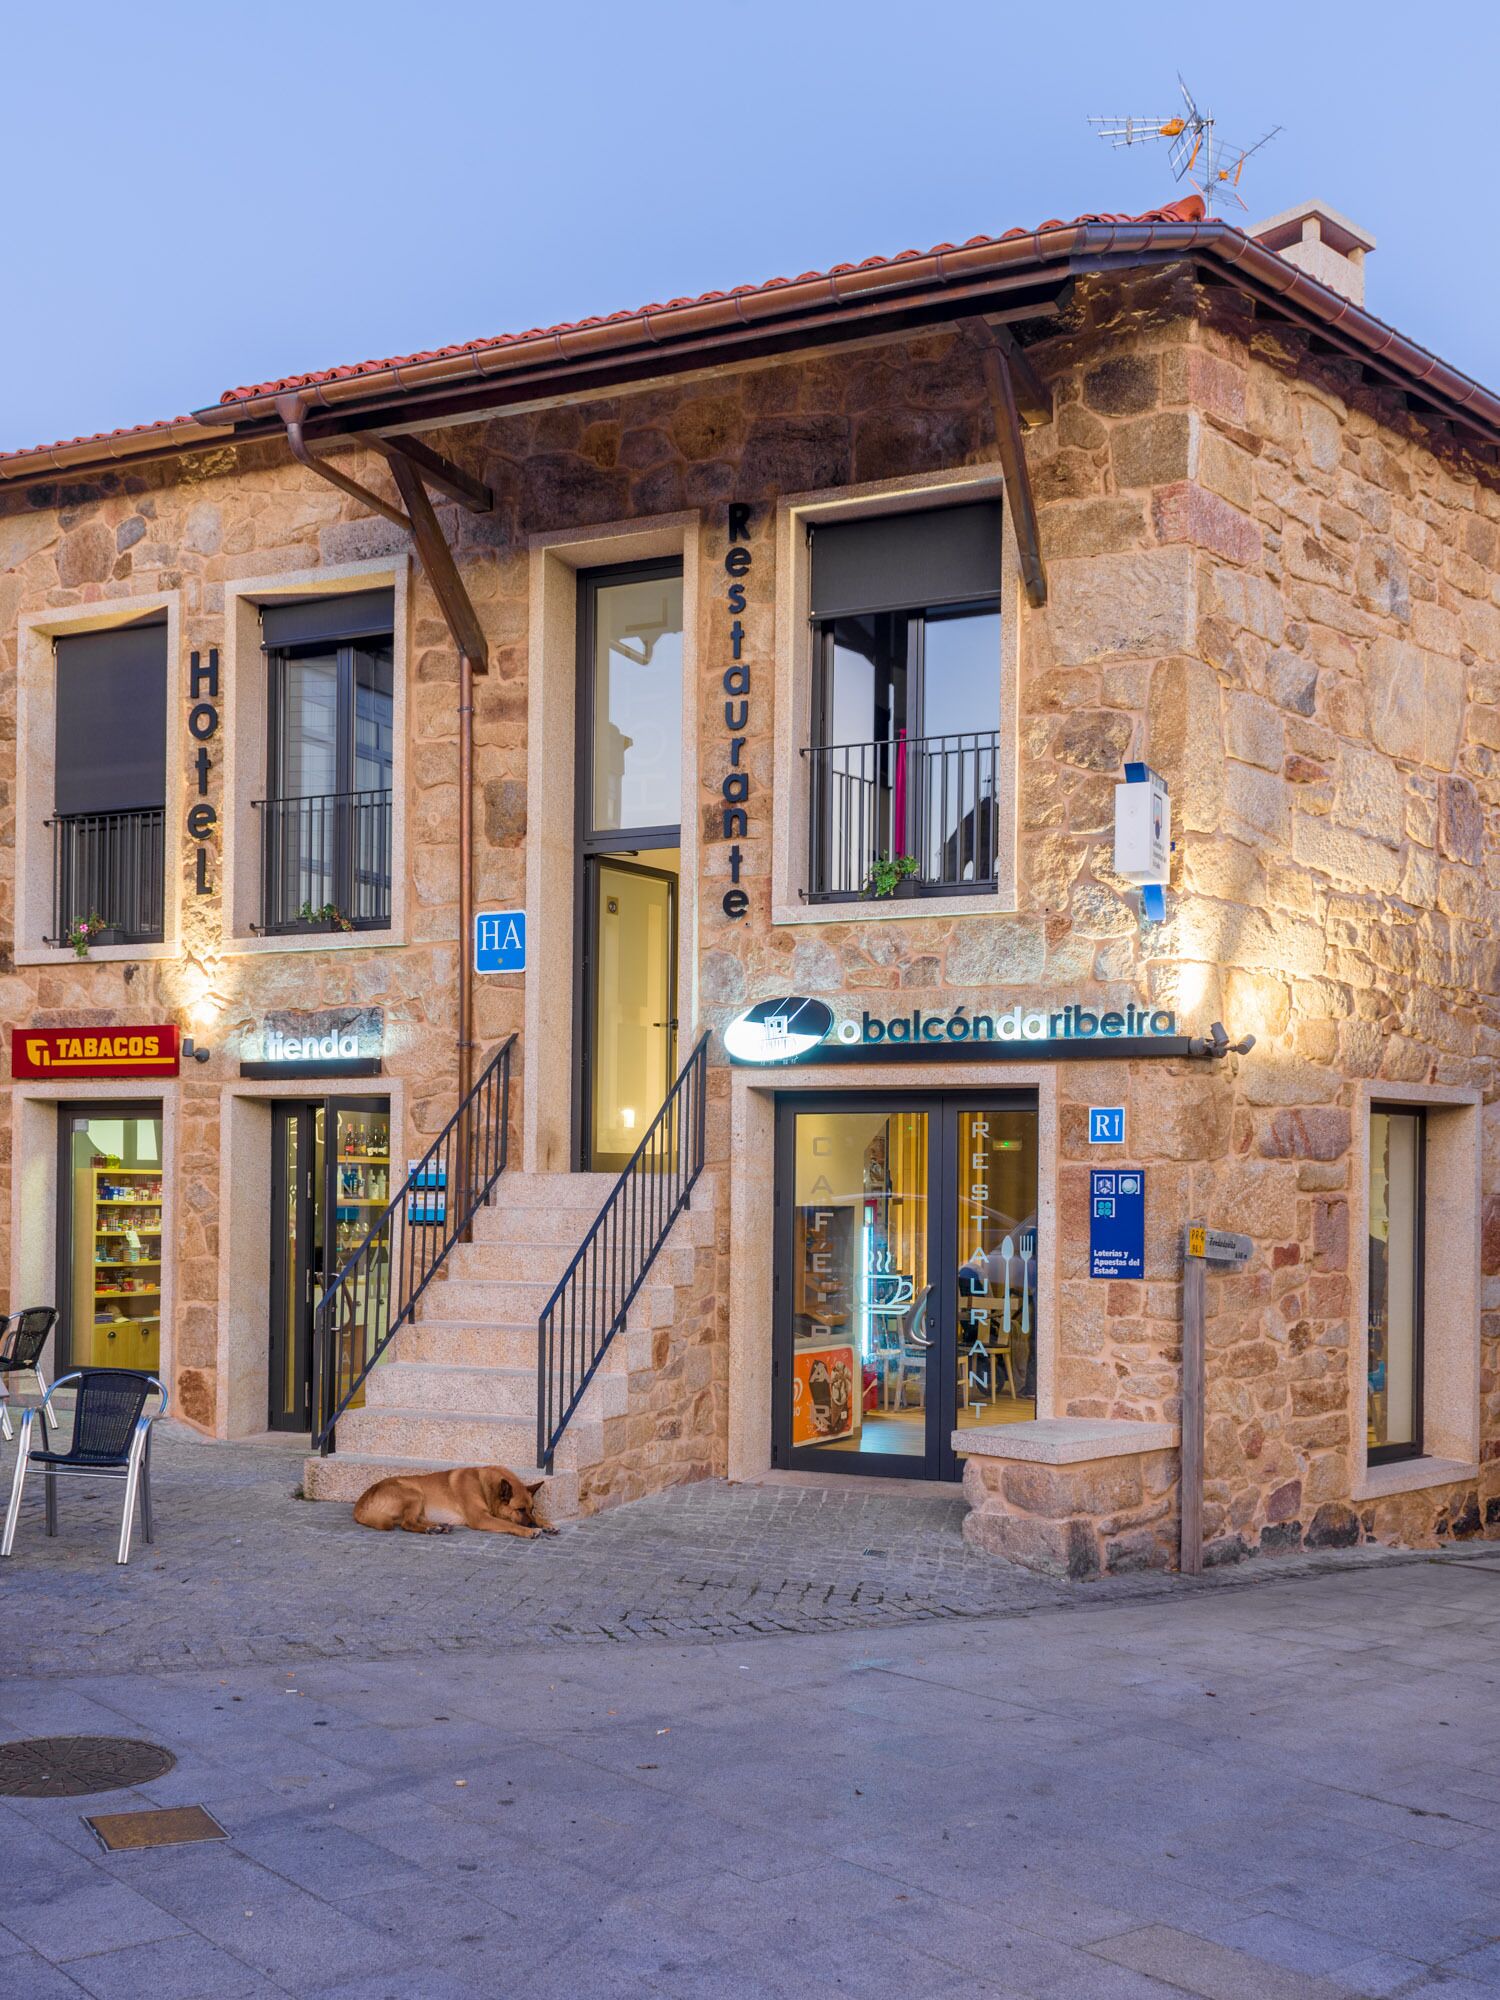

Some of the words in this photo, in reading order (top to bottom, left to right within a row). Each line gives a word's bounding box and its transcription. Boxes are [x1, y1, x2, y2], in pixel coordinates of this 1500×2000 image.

[722, 502, 752, 918] Restaurante
[480, 919, 523, 951] HA
[56, 1036, 160, 1058] TABACOS
[267, 1029, 359, 1060] tienda
[1093, 1258, 1127, 1267] Apuestas
[1128, 1258, 1140, 1266] del
[1123, 1251, 1129, 1259] y
[1093, 1267, 1119, 1275] Estado
